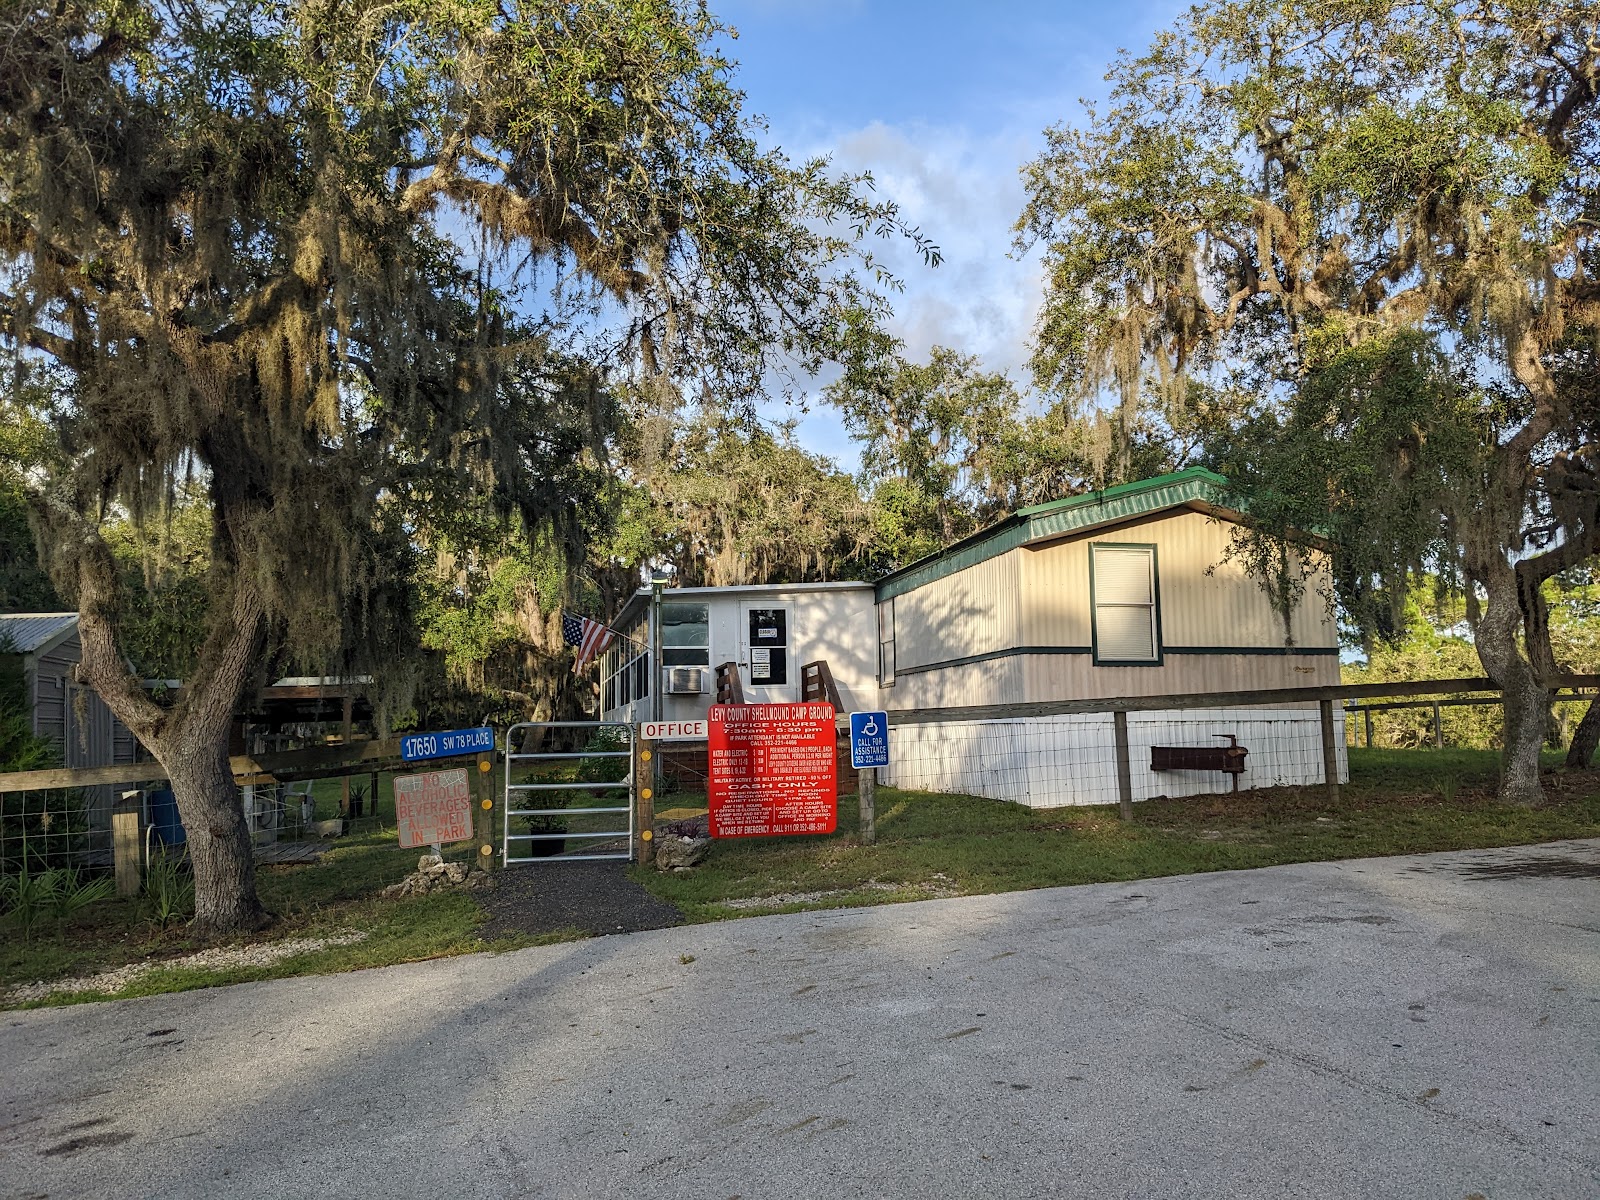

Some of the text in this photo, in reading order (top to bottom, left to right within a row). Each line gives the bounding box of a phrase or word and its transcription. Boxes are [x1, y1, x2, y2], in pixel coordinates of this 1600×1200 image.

[711, 706, 832, 721] LEVY COUNTY SHELLMOUND CAMP GROUND
[646, 723, 702, 736] OFFICE
[406, 732, 489, 757] 17650 SW 78 PLACE
[873, 737, 882, 745] FOR
[855, 746, 886, 755] ASSISTANCE
[855, 755, 886, 763] 352-221-4466
[423, 775, 439, 788] NO
[400, 784, 464, 805] ALCOHOLIC
[400, 798, 468, 818] BEVERAGES
[408, 812, 464, 831] ALLOWED
[412, 824, 466, 844] IN PARK
[724, 827, 736, 835] CASE
[745, 825, 770, 834] EMERGENCY
